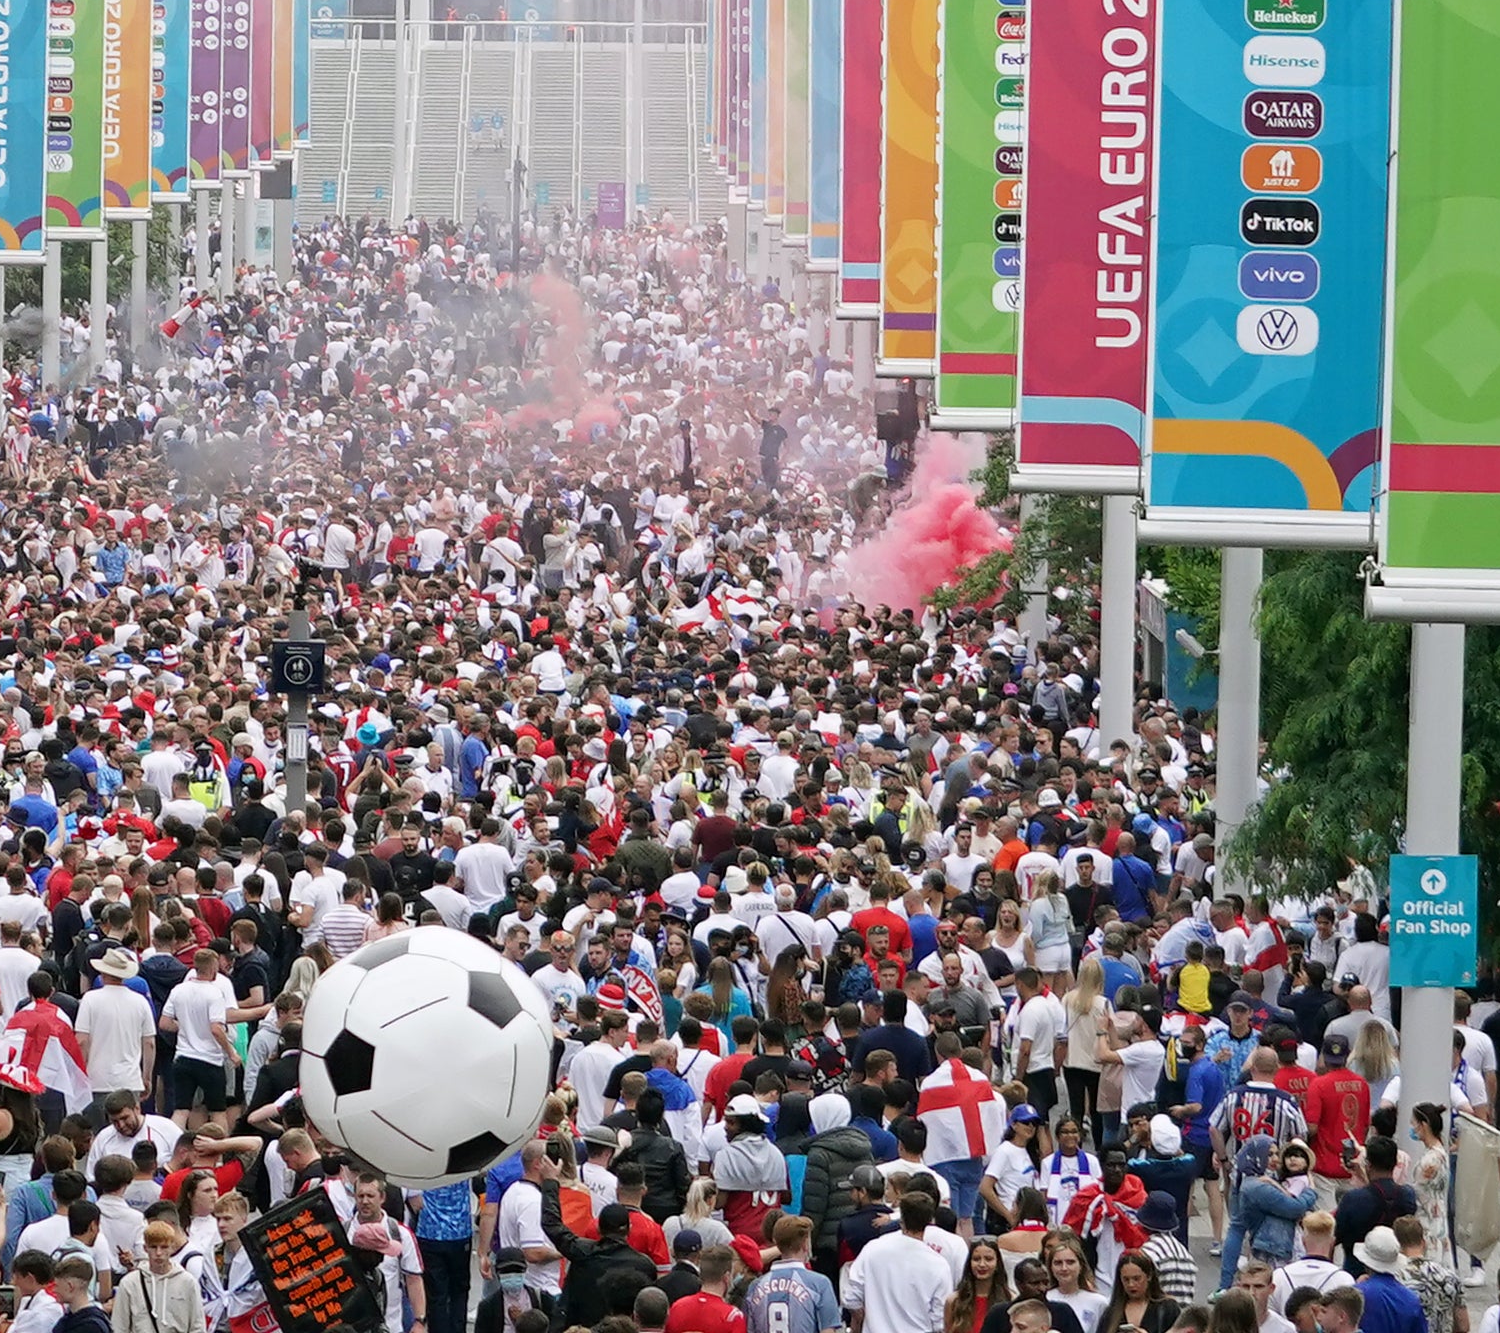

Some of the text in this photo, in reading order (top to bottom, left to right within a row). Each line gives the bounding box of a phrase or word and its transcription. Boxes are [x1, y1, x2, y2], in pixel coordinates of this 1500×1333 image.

[1254, 9, 1317, 24] Heineken
[1249, 54, 1320, 69] Hisense
[1100, 26, 1149, 186] EURO
[1251, 99, 1315, 120] QATAR
[1265, 117, 1316, 130] AIRWAYS
[1263, 178, 1300, 187] JUST EAT
[1263, 216, 1314, 233] TikTok
[1095, 195, 1145, 348] UEFA
[1253, 267, 1305, 284] vivo
[1402, 900, 1464, 917] Official
[1396, 920, 1471, 937] Fan Shop
[1342, 1093, 1359, 1131] 9
[1233, 1108, 1275, 1140] 86
[288, 1234, 305, 1248] the
[272, 1260, 289, 1273] the
[752, 1279, 810, 1306] GASCOIGNE
[289, 1304, 306, 1317] the
